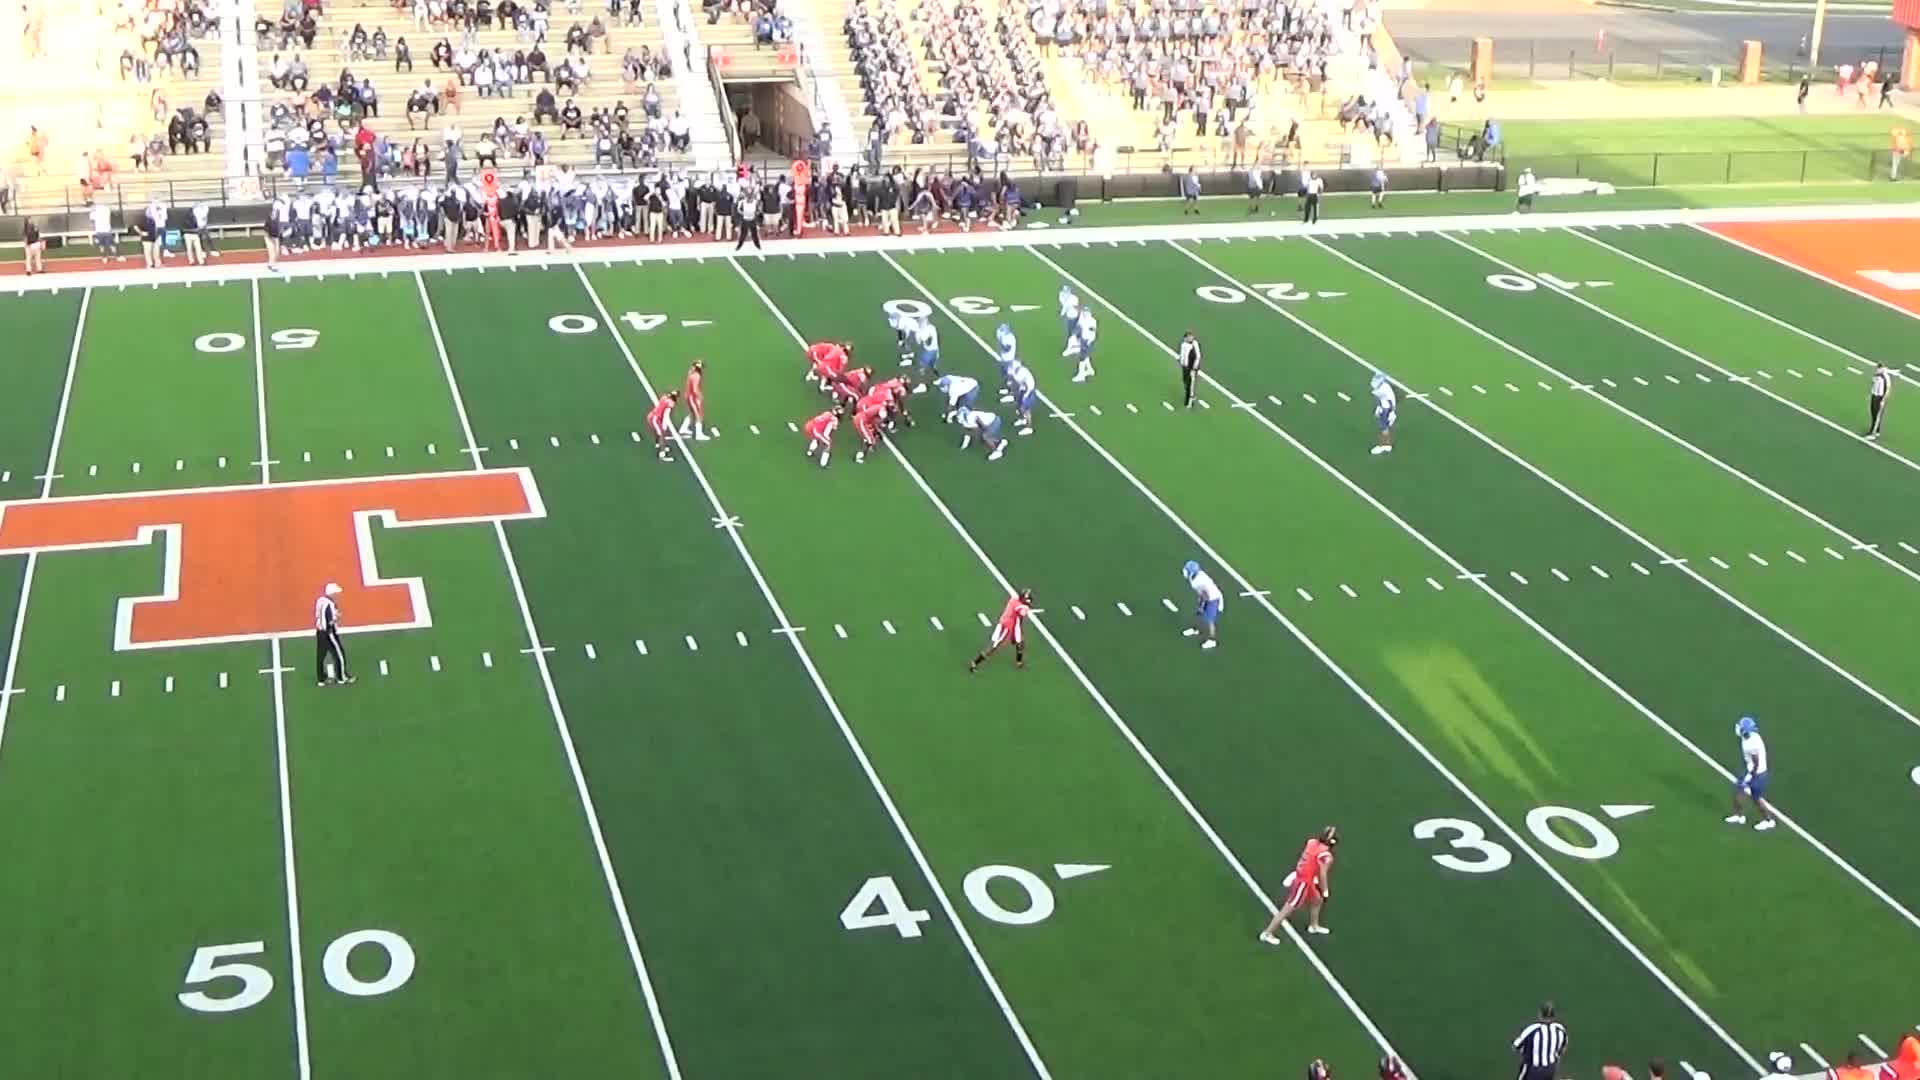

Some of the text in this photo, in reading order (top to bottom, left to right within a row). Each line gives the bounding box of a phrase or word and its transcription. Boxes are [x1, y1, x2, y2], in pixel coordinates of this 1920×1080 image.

[1196, 283, 1311, 305] 20
[1486, 272, 1580, 293] 10
[883, 296, 1001, 318] 30
[548, 311, 668, 335] 40
[194, 328, 321, 353] 50
[1413, 805, 1620, 873] 30
[840, 864, 1055, 938] 40
[178, 929, 416, 1012] 50
